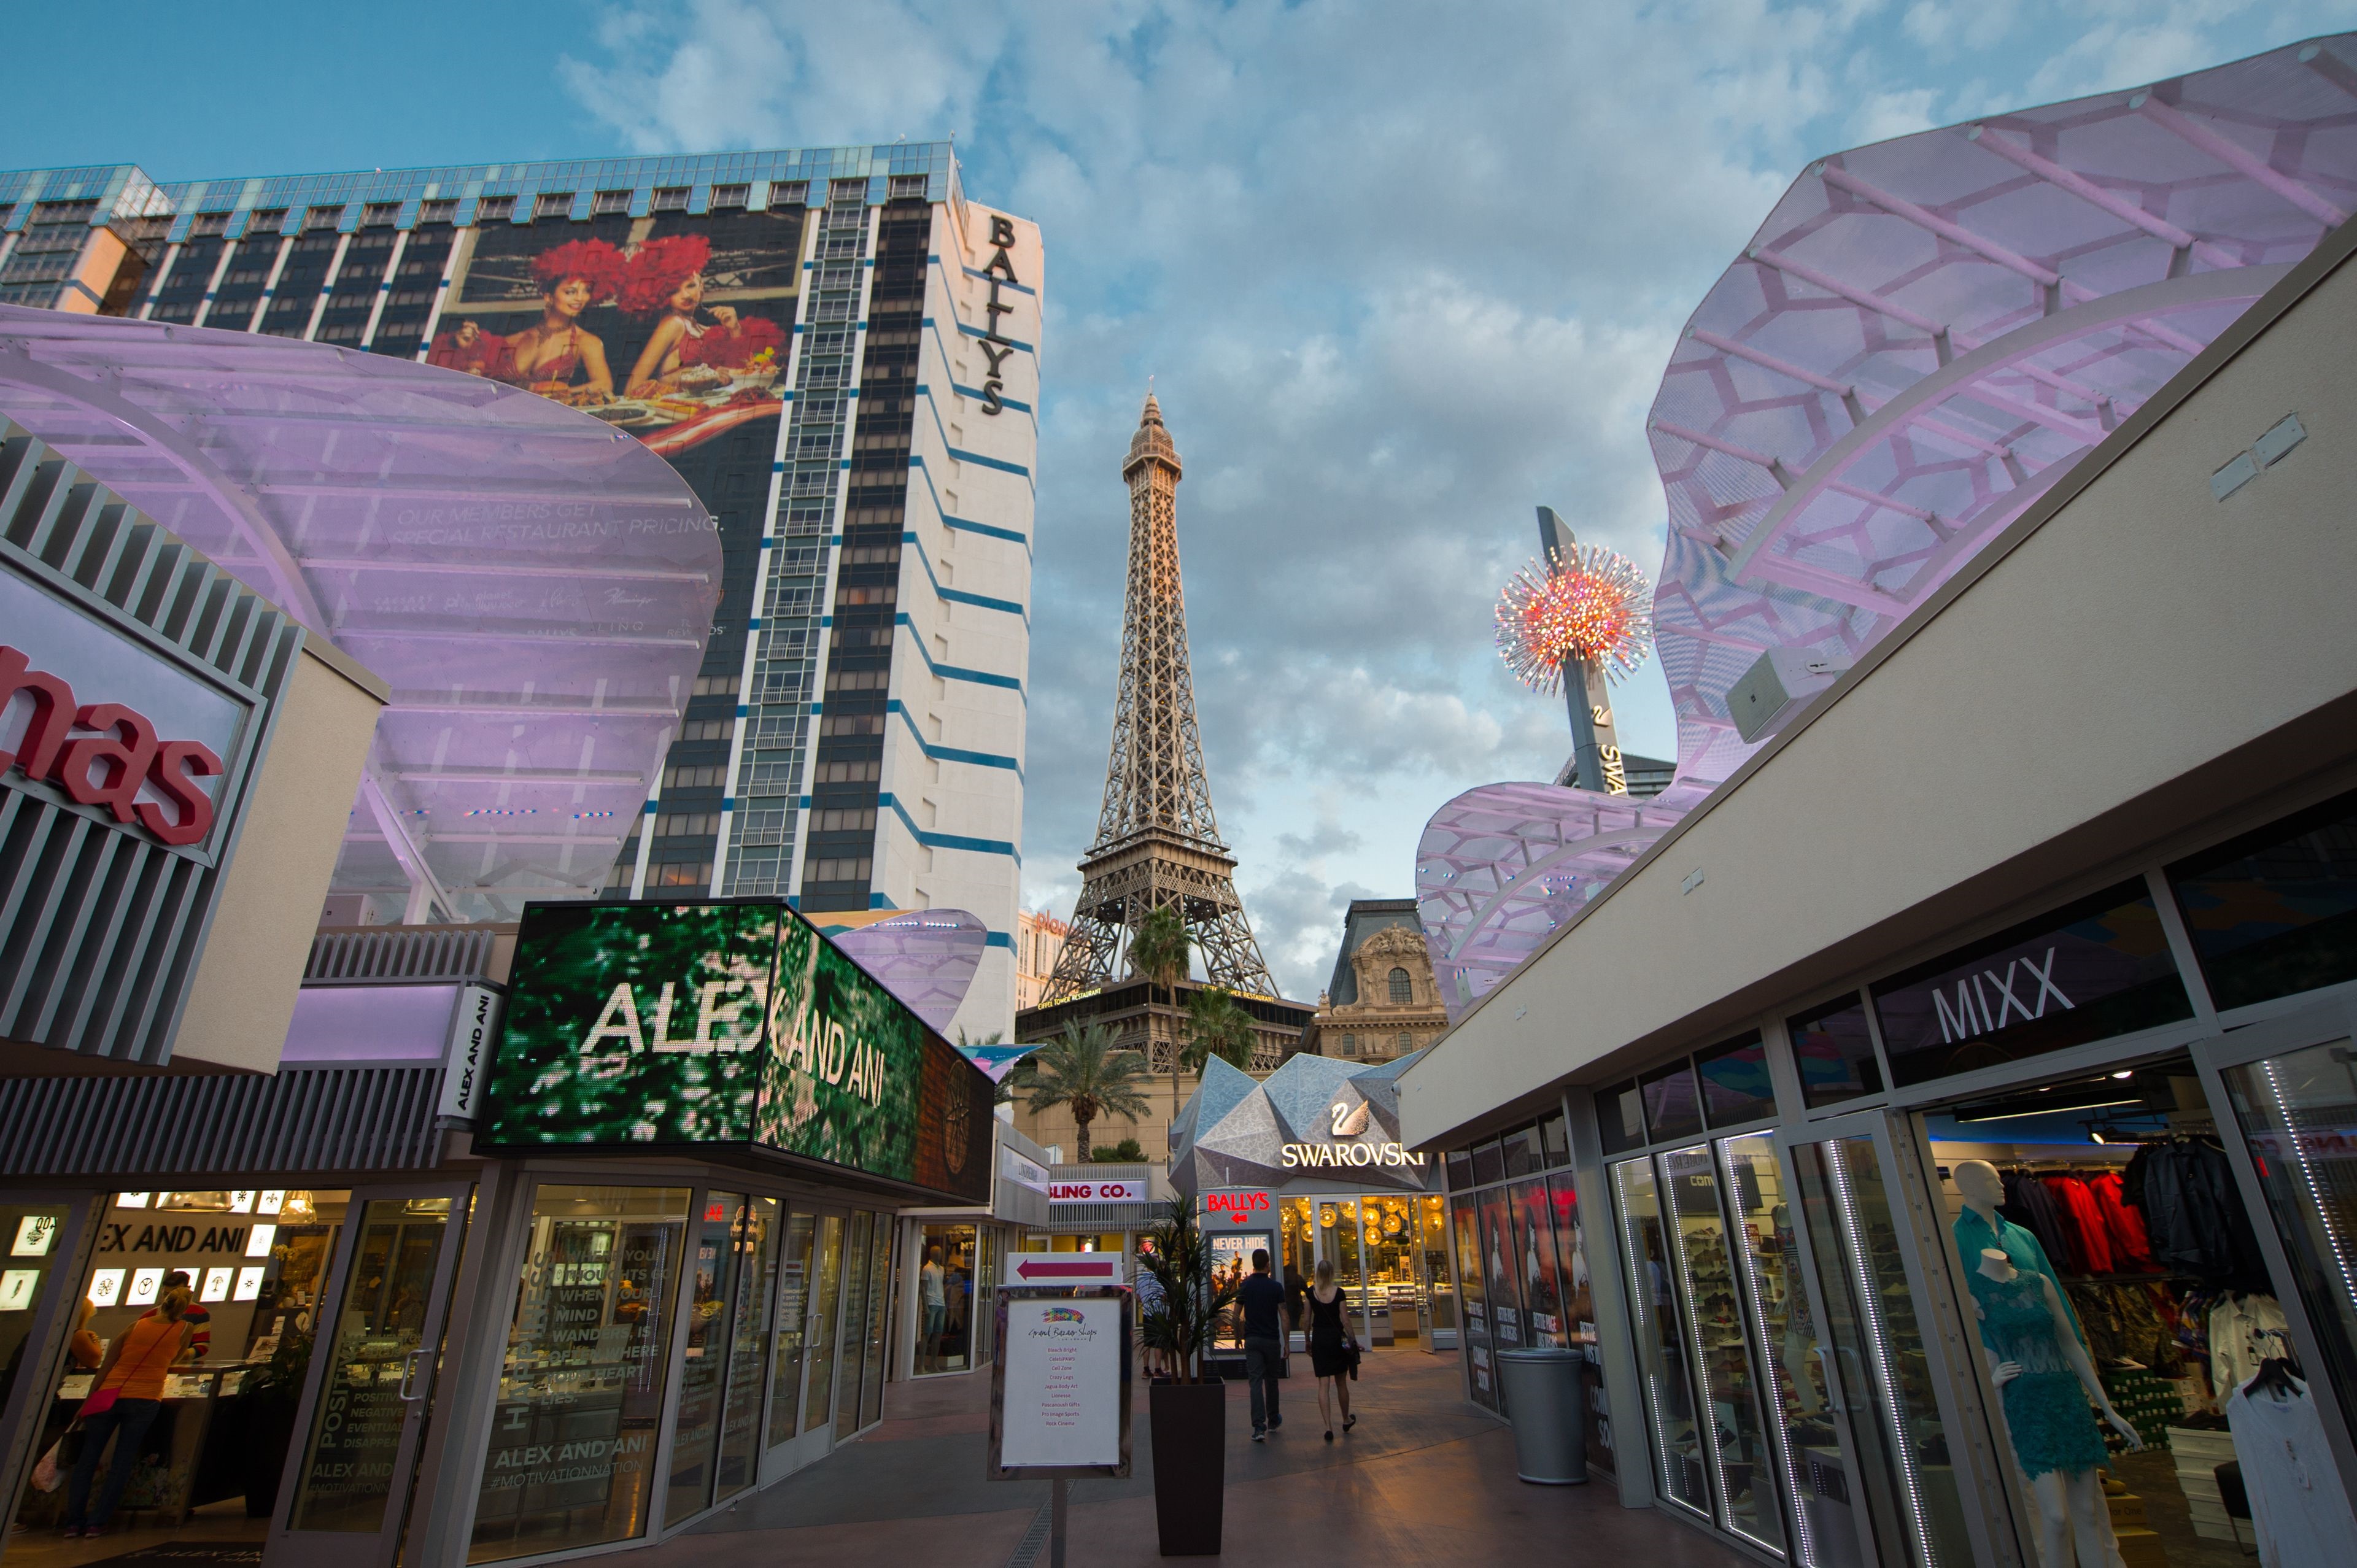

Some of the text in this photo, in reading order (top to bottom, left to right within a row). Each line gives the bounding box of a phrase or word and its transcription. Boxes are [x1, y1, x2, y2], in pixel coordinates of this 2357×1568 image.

[398, 503, 595, 525] OUR MEMBERS GET
[393, 516, 724, 545] SPECIAL RESTAURANT PRICING.
[1932, 947, 2075, 1043] MIXX
[579, 979, 885, 1108] ALEX AND ANI
[457, 995, 490, 1111] ALEX AND ANI
[1281, 1141, 1426, 1167] SWAROVSKI
[1100, 1184, 1132, 1199] CO.
[1207, 1192, 1270, 1211] BALLY'S
[132, 1225, 197, 1253] AND
[197, 1226, 245, 1253] ANI
[1212, 1236, 1267, 1250] NEVER HIDE
[563, 1267, 648, 1281] THOUGHTS
[559, 1287, 652, 1302] WHEN YOUR
[555, 1308, 598, 1323] MIND
[503, 1251, 555, 1431] HAPPINESS
[552, 1326, 651, 1343] WANDERS, IS
[1028, 1323, 1097, 1342] Grand Bazaar Shops
[549, 1345, 659, 1363] OFTEN WHERE
[1473, 1345, 1489, 1370] COMING
[595, 1365, 646, 1380] HEART
[1477, 1369, 1490, 1392] SOON
[1589, 1384, 1609, 1415] COM
[350, 1407, 404, 1418] NEGATIVE
[347, 1423, 403, 1433] EVENTUAL
[689, 1427, 704, 1442] AND
[343, 1438, 399, 1448] DISAPPEA
[493, 1445, 555, 1469] ALEX
[557, 1440, 606, 1462] AND
[610, 1434, 648, 1456] ANI
[311, 1462, 393, 1478] ALEX AND
[490, 1458, 644, 1489] #MOTIVATIONNATION
[309, 1482, 390, 1494] #MOTIVATIONN
[2123, 1507, 2142, 1516] One
